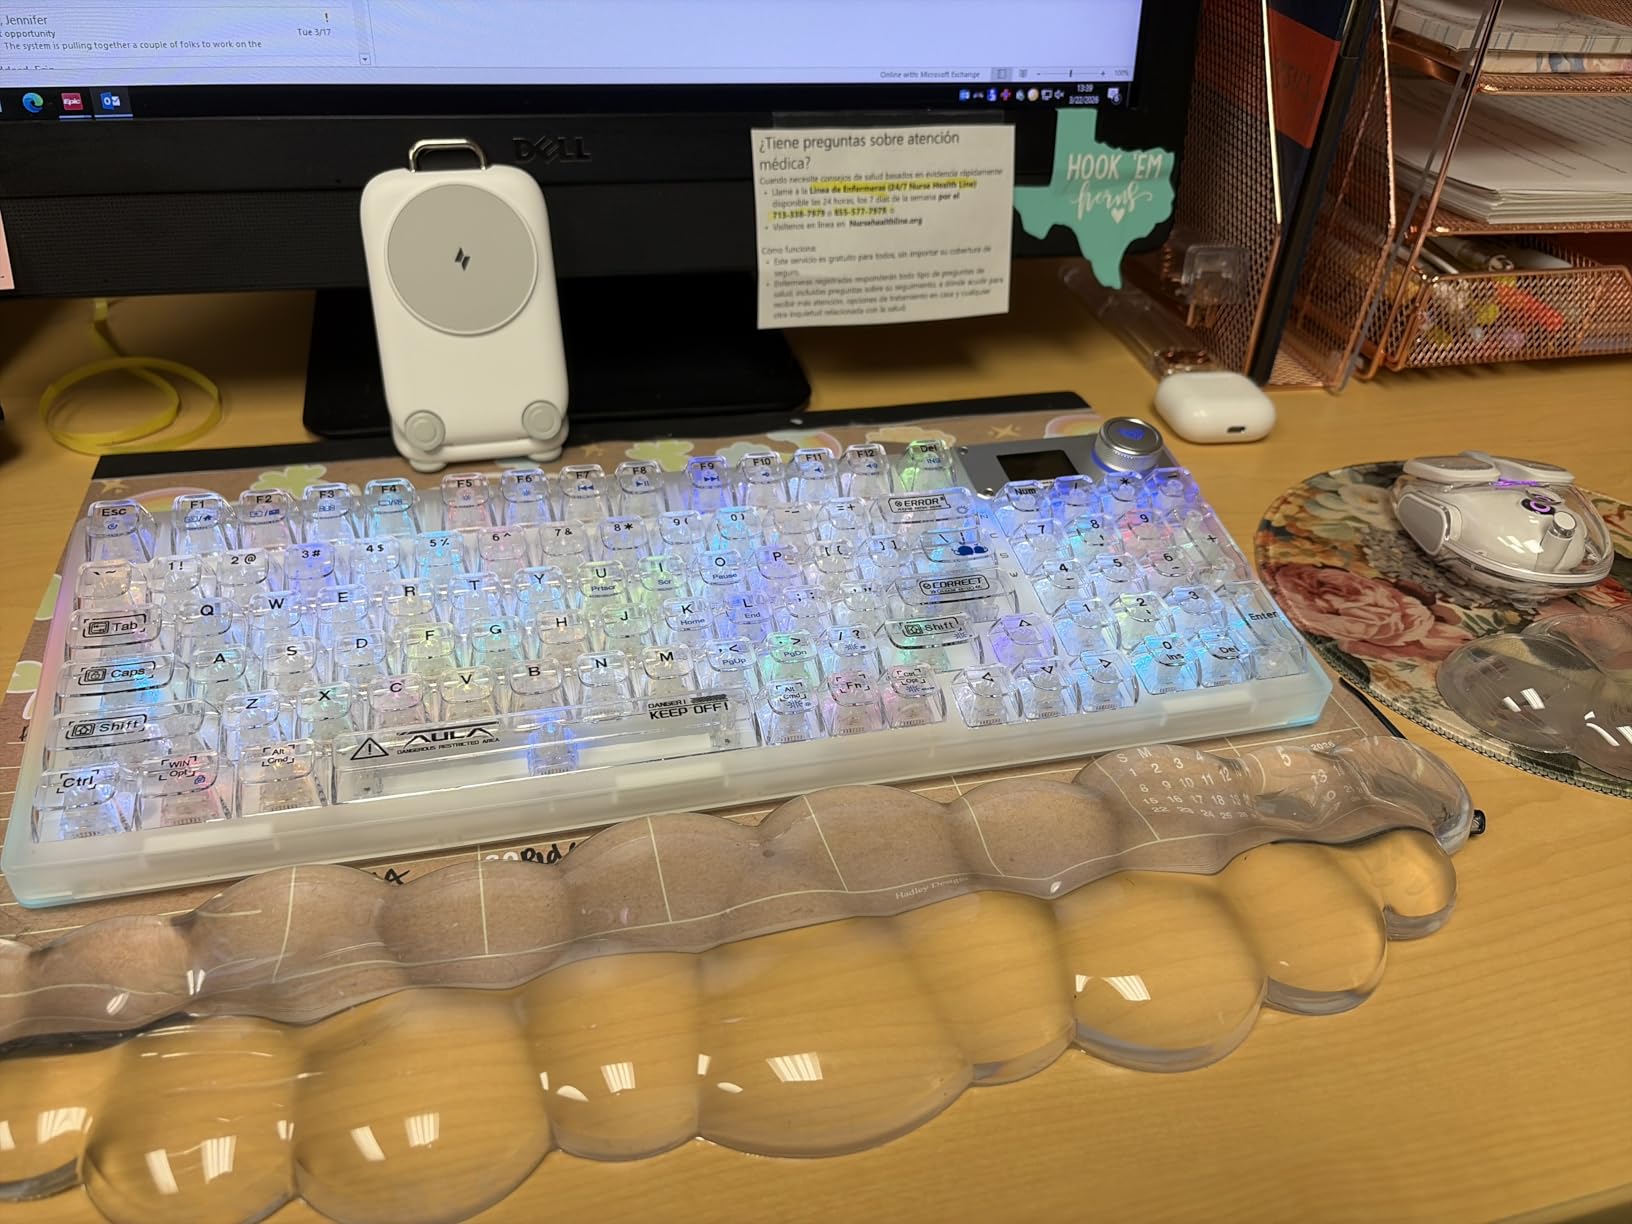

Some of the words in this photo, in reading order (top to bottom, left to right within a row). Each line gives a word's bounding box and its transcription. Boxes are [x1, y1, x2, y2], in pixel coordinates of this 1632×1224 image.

[6, 16, 47, 25] Jennifer
[297, 28, 312, 36] Tue
[315, 28, 331, 36] 3/17
[94, 42, 130, 50] together
[140, 41, 167, 49] couple
[759, 136, 799, 153] ¿Tiene
[804, 135, 865, 152] preguntas
[871, 132, 904, 146] sobre
[908, 130, 960, 145] atención
[512, 136, 592, 163] DELL
[759, 156, 811, 171] médica?
[1067, 154, 1122, 180] HOOK
[1133, 153, 1163, 180] 'EM
[760, 177, 787, 185] Cuando
[772, 188, 793, 196] Llame
[888, 183, 907, 192] (24/7
[909, 182, 930, 190] Nurse
[933, 180, 957, 188] Health
[959, 180, 977, 189] Line)
[773, 199, 808, 208] disponible
[938, 194, 951, 202] por
[920, 444, 938, 453] Del
[805, 453, 822, 461] F11
[857, 450, 875, 458] F12
[700, 462, 714, 471] F9
[753, 457, 771, 466] F10
[576, 471, 591, 479] F7
[632, 466, 647, 475] F8
[457, 479, 473, 487] F5
[517, 475, 532, 483] F6
[380, 484, 397, 494] F4
[1014, 486, 1036, 496] Num
[256, 494, 272, 504] F2
[319, 490, 335, 499] F3
[190, 500, 205, 509] F1
[903, 497, 939, 507] ERROR
[101, 508, 127, 517] Esc
[1139, 513, 1150, 523] 9
[1037, 524, 1046, 534] 7
[1090, 519, 1100, 529] 8
[772, 551, 782, 561] P
[1163, 552, 1173, 562] 6
[714, 557, 726, 567] O
[1113, 558, 1122, 568] 5
[596, 568, 607, 577] U
[1058, 563, 1068, 573] 4
[534, 573, 545, 584] Y
[933, 577, 982, 588] CORRECT
[468, 579, 481, 591] T
[404, 586, 416, 596] R
[1190, 591, 1200, 600] 3
[338, 592, 348, 603] E
[1135, 597, 1146, 607] 2
[268, 598, 285, 609] W
[742, 598, 753, 608] L
[200, 604, 214, 616] Q
[680, 604, 693, 614] K
[620, 611, 629, 621] J
[744, 611, 761, 619] End
[1248, 610, 1280, 622] Enter
[112, 621, 138, 632] Tab
[556, 617, 568, 628] H
[680, 618, 706, 627] Home
[925, 622, 954, 631] Shift
[489, 624, 502, 635] G
[425, 630, 435, 641] F
[356, 638, 368, 649] D
[1162, 641, 1173, 650] 0
[286, 645, 298, 656] S
[783, 649, 807, 658] PgDn
[1218, 645, 1239, 655] Del
[213, 653, 226, 664] A
[659, 651, 674, 662] M
[721, 657, 746, 666] PgUp
[1166, 652, 1185, 661] Ins
[595, 658, 608, 668] N
[110, 667, 146, 679] Caps
[528, 666, 541, 677] B
[460, 674, 472, 685] V
[389, 682, 402, 692] C
[319, 691, 332, 701] X
[246, 698, 259, 709] Z
[650, 707, 688, 719] KEEP
[98, 719, 139, 733] Shift
[403, 727, 494, 747] AULA
[272, 748, 285, 756] Alt
[397, 745, 437, 755] DANGEROUS
[438, 740, 480, 751] RESTRICTED
[1117, 753, 1128, 763] S
[1136, 746, 1152, 759] M
[169, 760, 191, 769] WIN
[267, 756, 288, 764] Cmd
[1129, 767, 1137, 777] 1
[1151, 763, 1162, 773] 2
[1173, 757, 1183, 769] 3
[1196, 751, 1203, 760] 4
[169, 769, 188, 778] Opt
[62, 777, 94, 788] Ctrl
[1139, 783, 1149, 793] 8
[1162, 780, 1171, 789] 9
[1179, 777, 1194, 788] 10
[1201, 773, 1214, 785] 11
[1219, 767, 1231, 782] 12
[1142, 797, 1159, 805] 15
[1167, 794, 1183, 803] 16
[1190, 794, 1203, 804] 17
[1211, 794, 1225, 806] 18
[895, 886, 928, 899] Hadley
